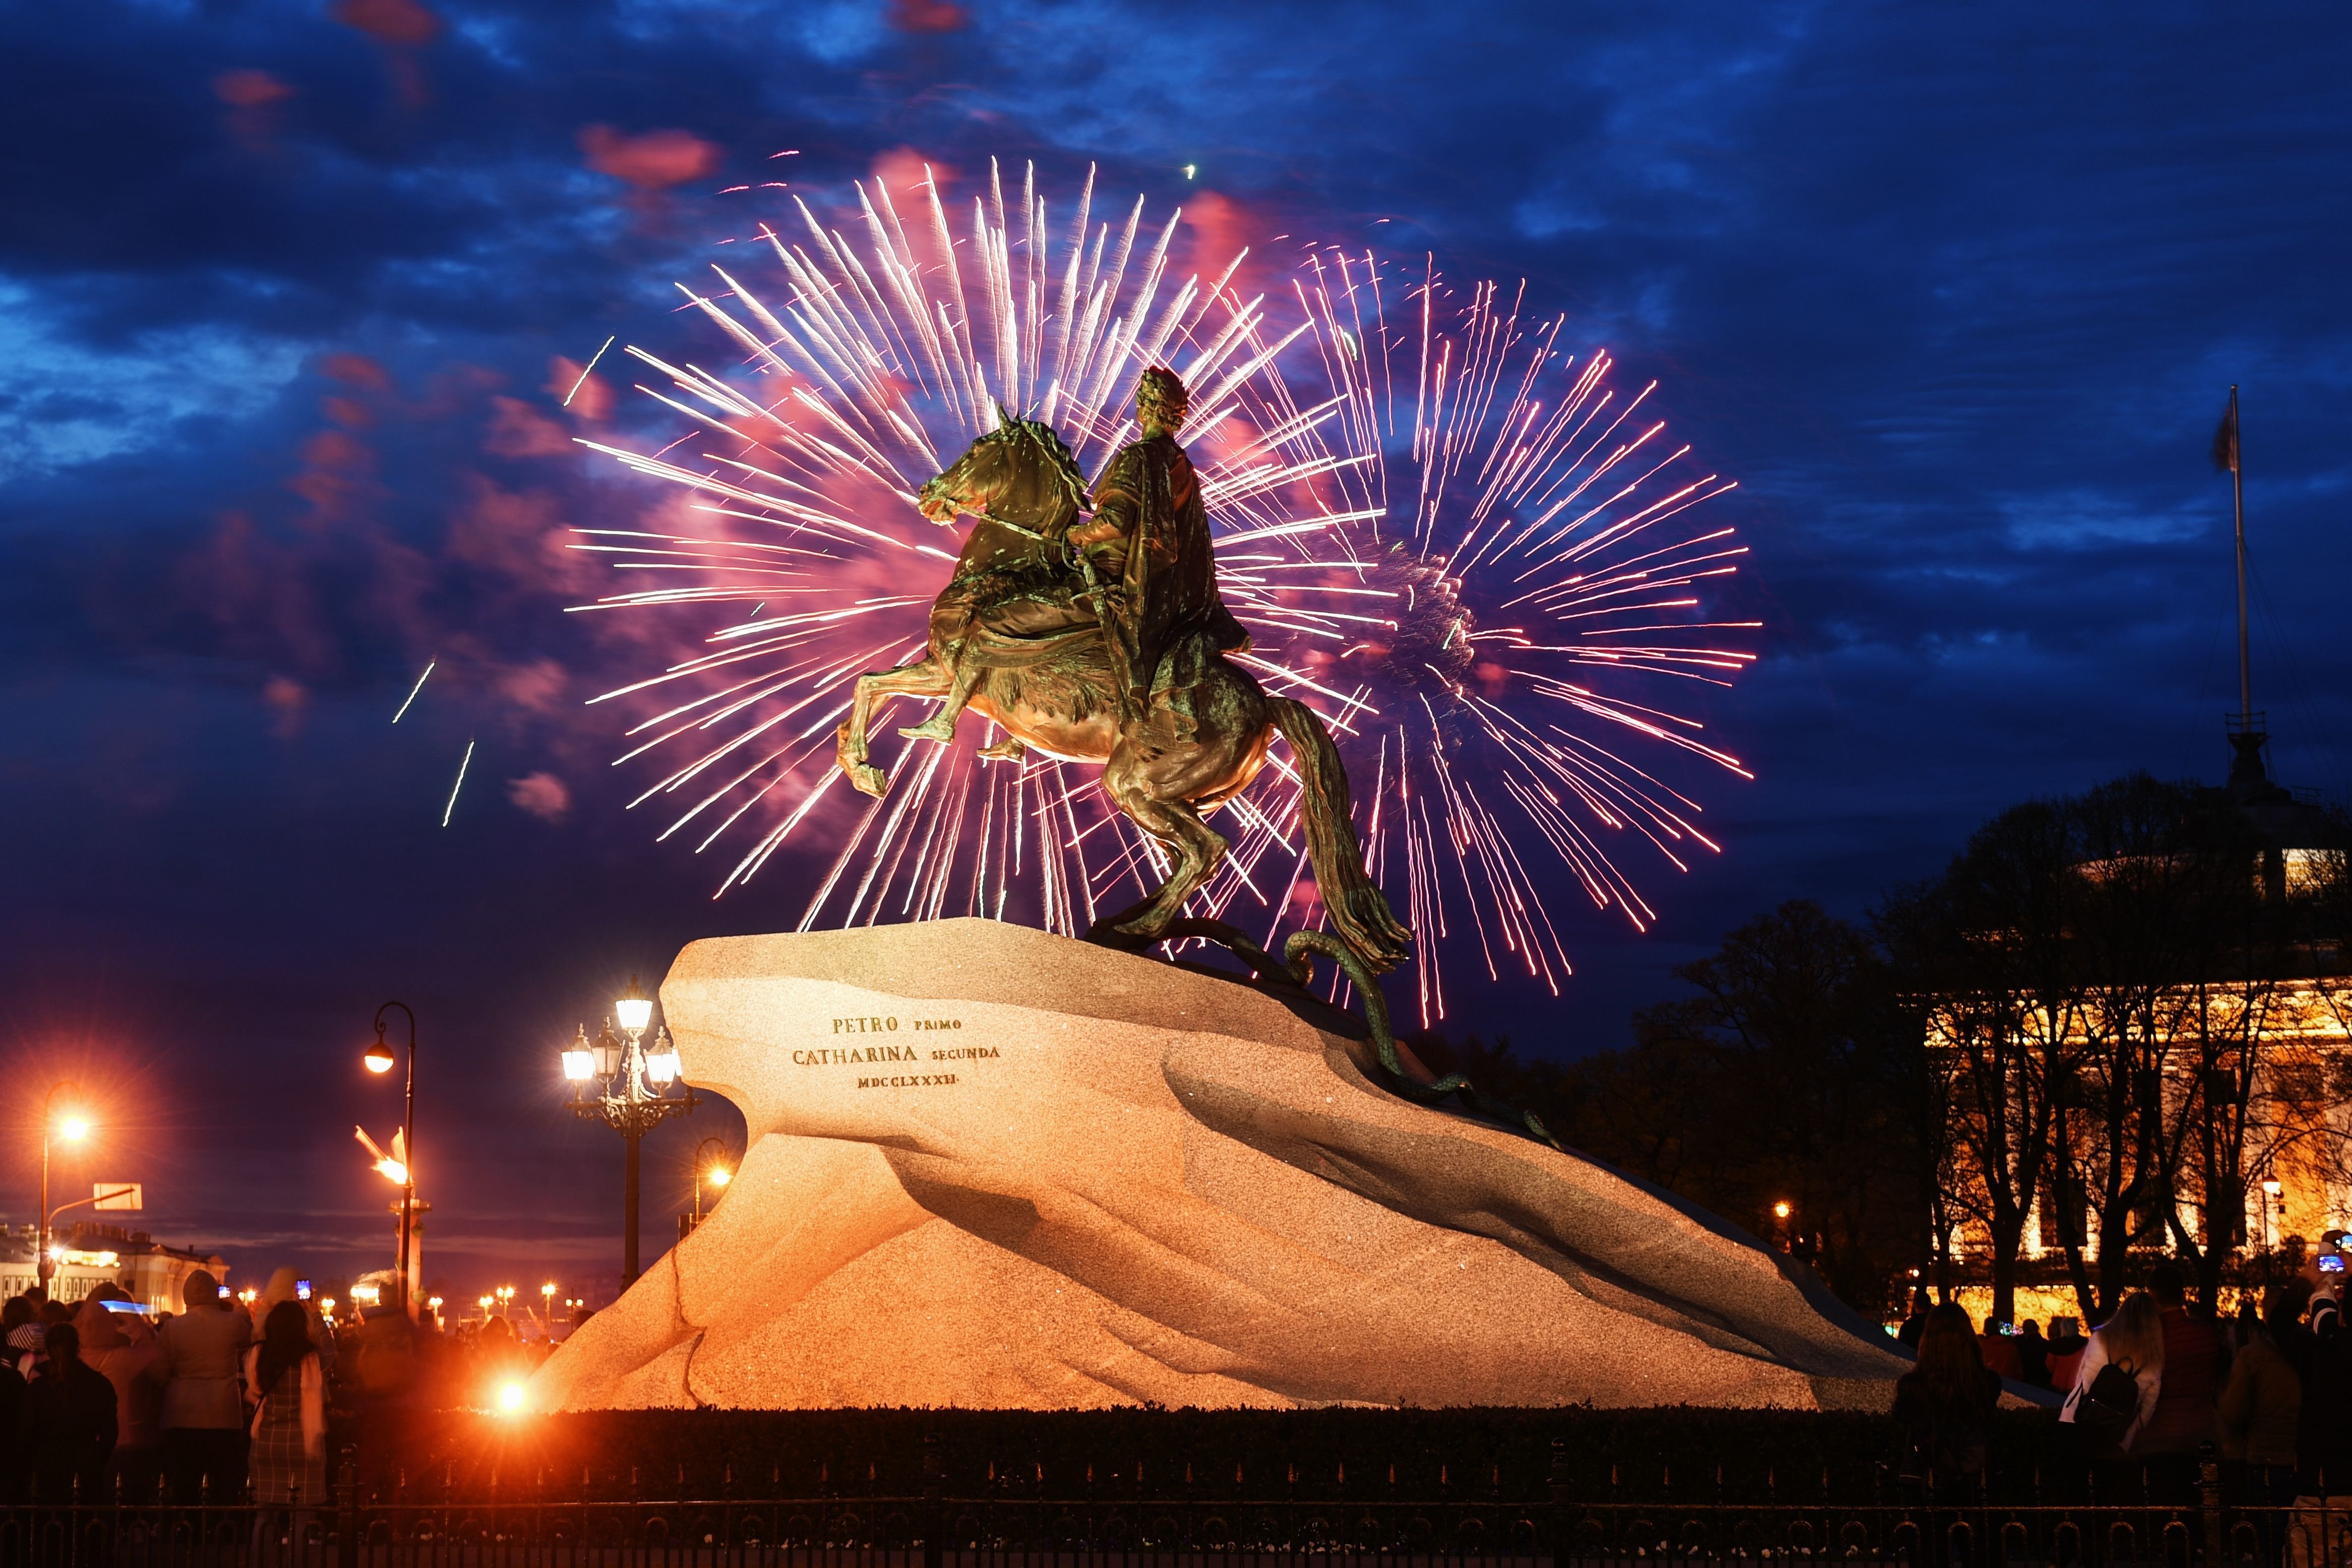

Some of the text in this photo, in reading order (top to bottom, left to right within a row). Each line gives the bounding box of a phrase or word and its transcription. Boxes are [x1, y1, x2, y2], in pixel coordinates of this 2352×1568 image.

[833, 1017, 961, 1034] PETRO PRIMO
[793, 1046, 1000, 1065] CATHARINA SECUNDA
